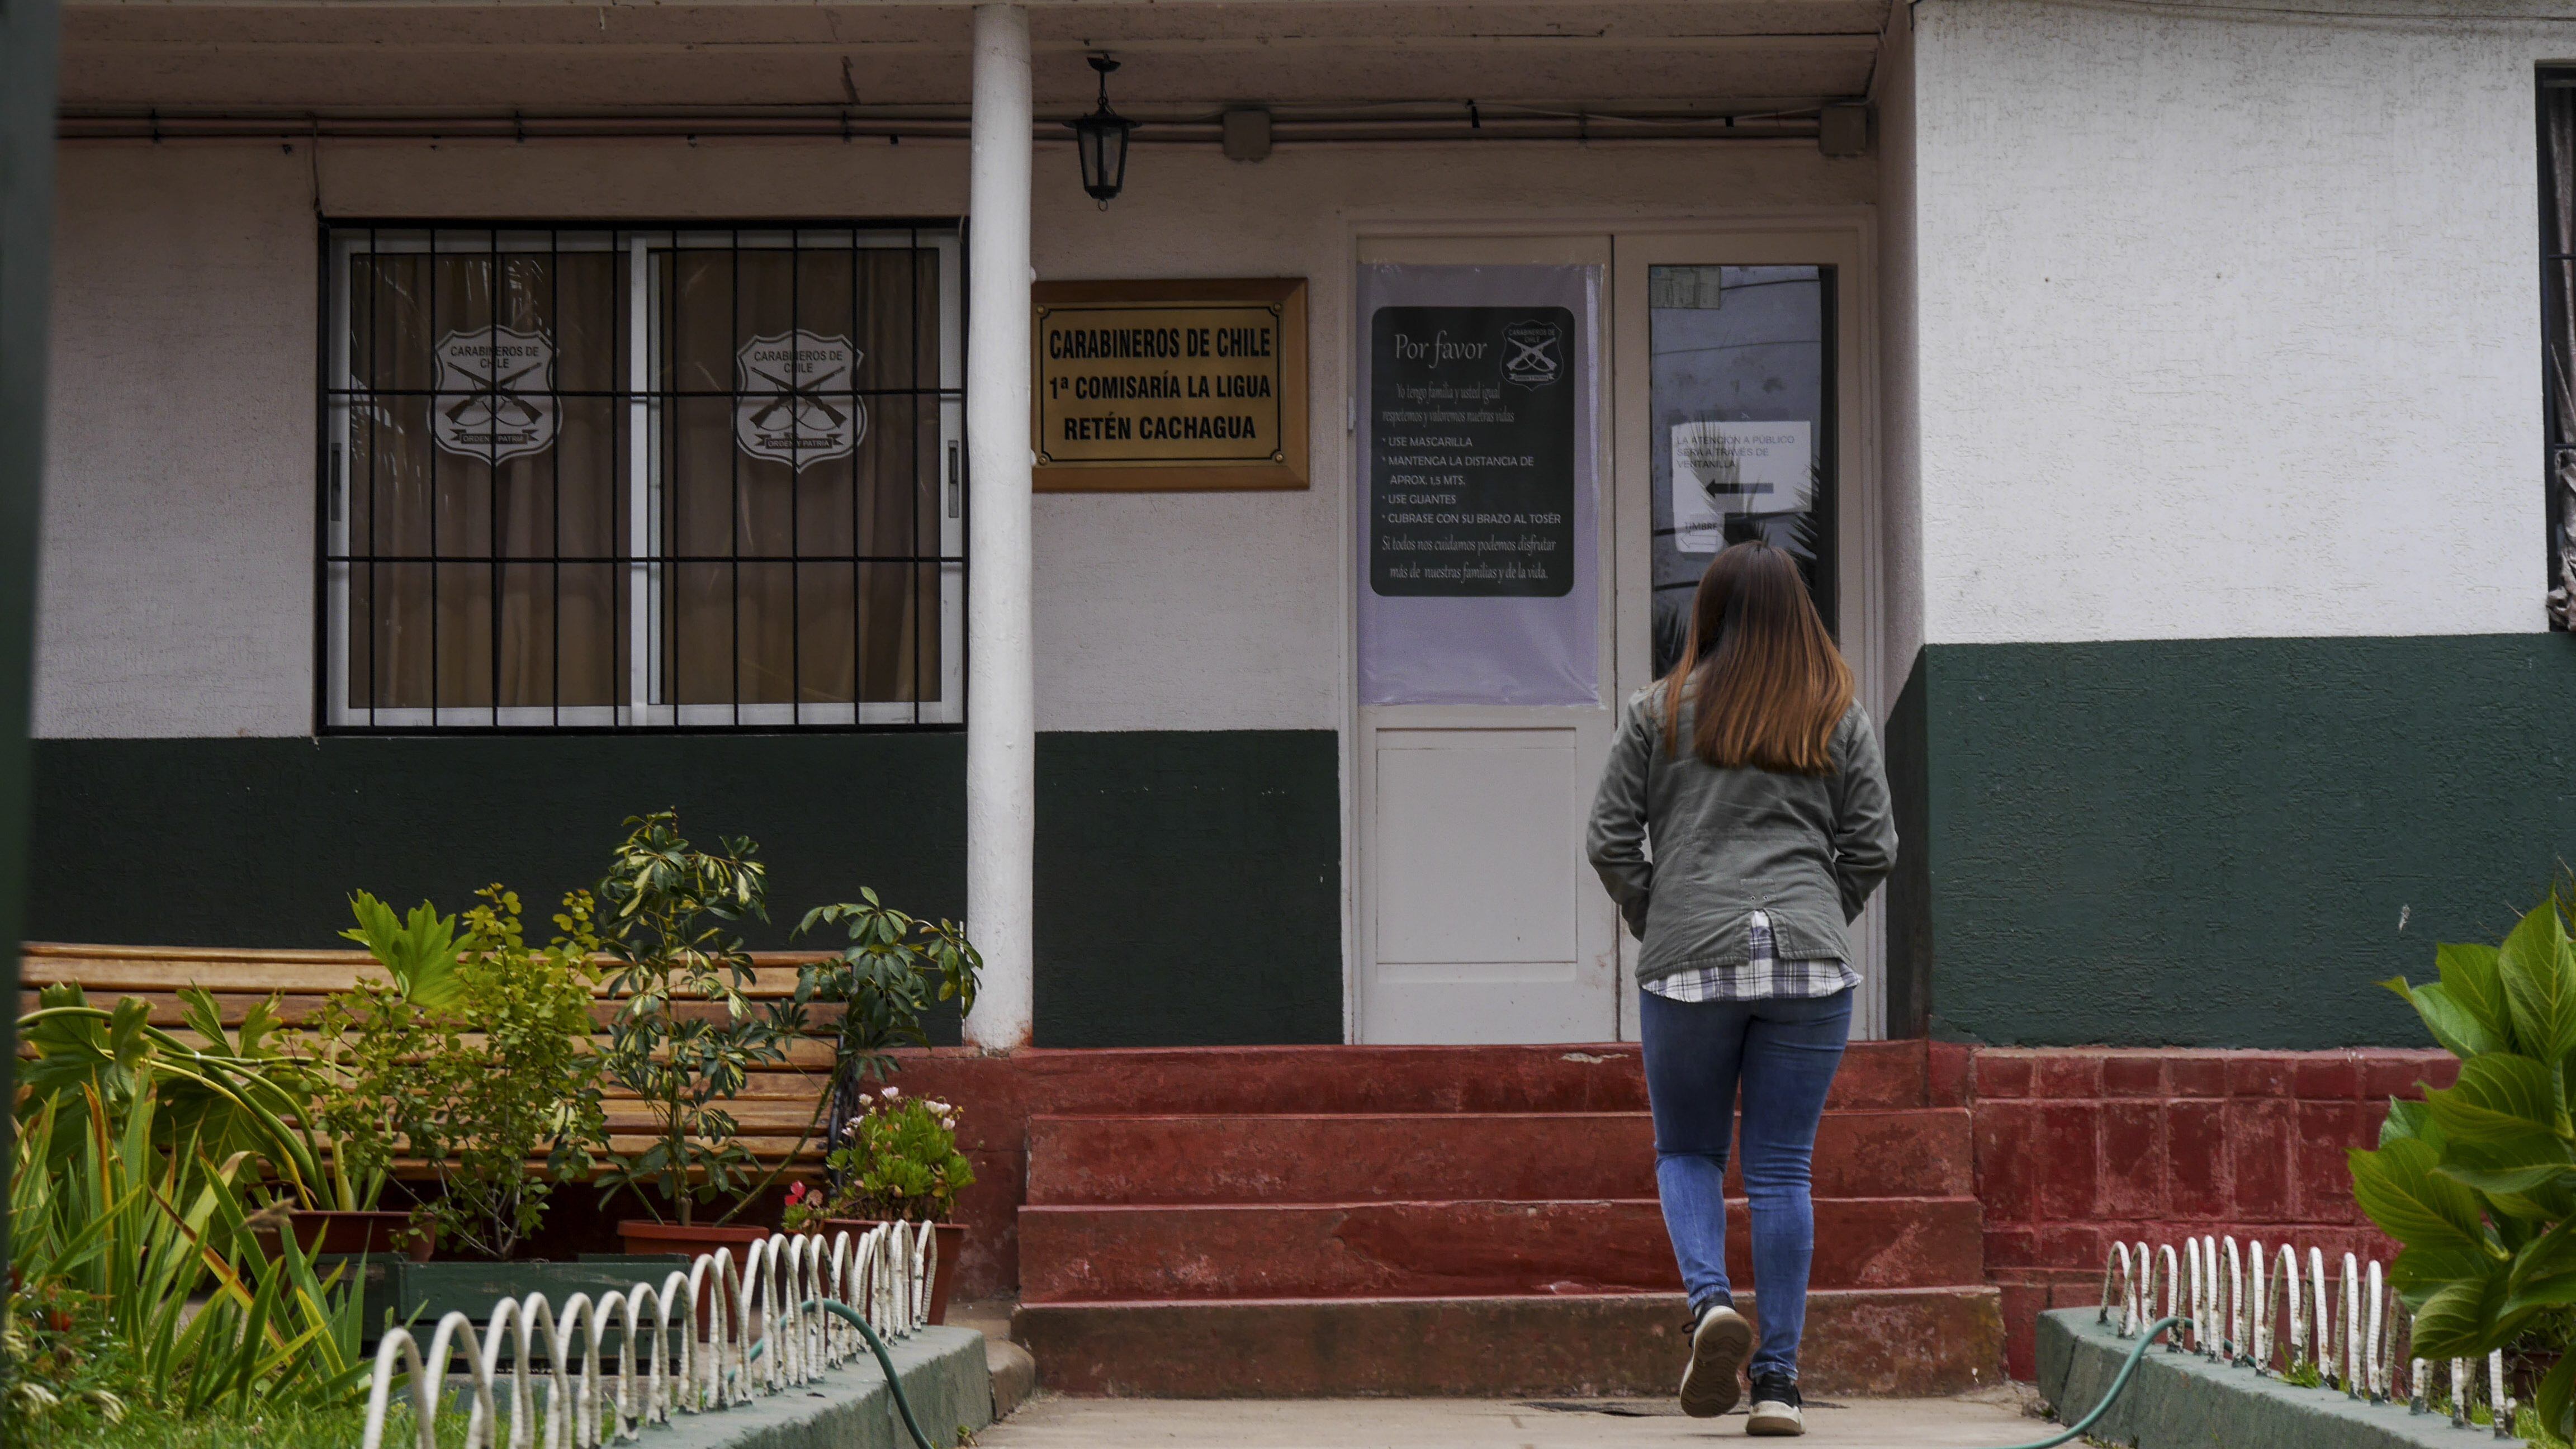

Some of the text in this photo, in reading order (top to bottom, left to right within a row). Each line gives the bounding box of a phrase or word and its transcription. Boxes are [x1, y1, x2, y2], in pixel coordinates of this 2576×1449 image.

[1049, 328, 1271, 359] CARABINEROS DE CHILE
[526, 347, 539, 357] DE
[1395, 330, 1488, 369] Por favor
[754, 351, 843, 361] CARABIEROS DE
[480, 358, 509, 368] CHLE
[784, 363, 813, 373] CILE
[1076, 370, 1181, 399] COMISARÍA
[1187, 376, 1210, 398] LA
[1217, 375, 1271, 398] LIGUA
[1407, 383, 1427, 404] tengo
[1453, 388, 1459, 405] y
[1460, 381, 1480, 399] usted
[1481, 381, 1500, 405] igual
[1064, 412, 1256, 441] RETÉN CACHAGUA
[1388, 437, 1473, 447] USE MASCARILLA
[1677, 436, 1689, 445] LA
[1743, 435, 1751, 444] A
[1705, 448, 1715, 457] A
[1755, 447, 1769, 457] DE
[1389, 456, 1534, 467] MANTENGA LA DISTANCIA DE
[1677, 460, 1736, 468] VENTANILLA
[1390, 475, 1427, 485] APROX.
[1443, 475, 1466, 486] MTS.
[1388, 494, 1456, 504] USE GUANTES
[1388, 513, 1434, 524] CUBRASE
[1436, 513, 1459, 524] CON
[1461, 513, 1474, 524] SU
[1476, 513, 1511, 524] BRAZO
[1513, 513, 1527, 524] AL
[1382, 533, 1556, 556] Si todos nos cuidamos podemos disfrutar
[1409, 561, 1420, 579] de
[1424, 564, 1461, 579] nuestras
[1460, 561, 1497, 584] familias
[1497, 568, 1504, 584] y
[1505, 561, 1517, 579] de
[1518, 562, 1527, 579] la
[1527, 561, 1549, 579] vida.
